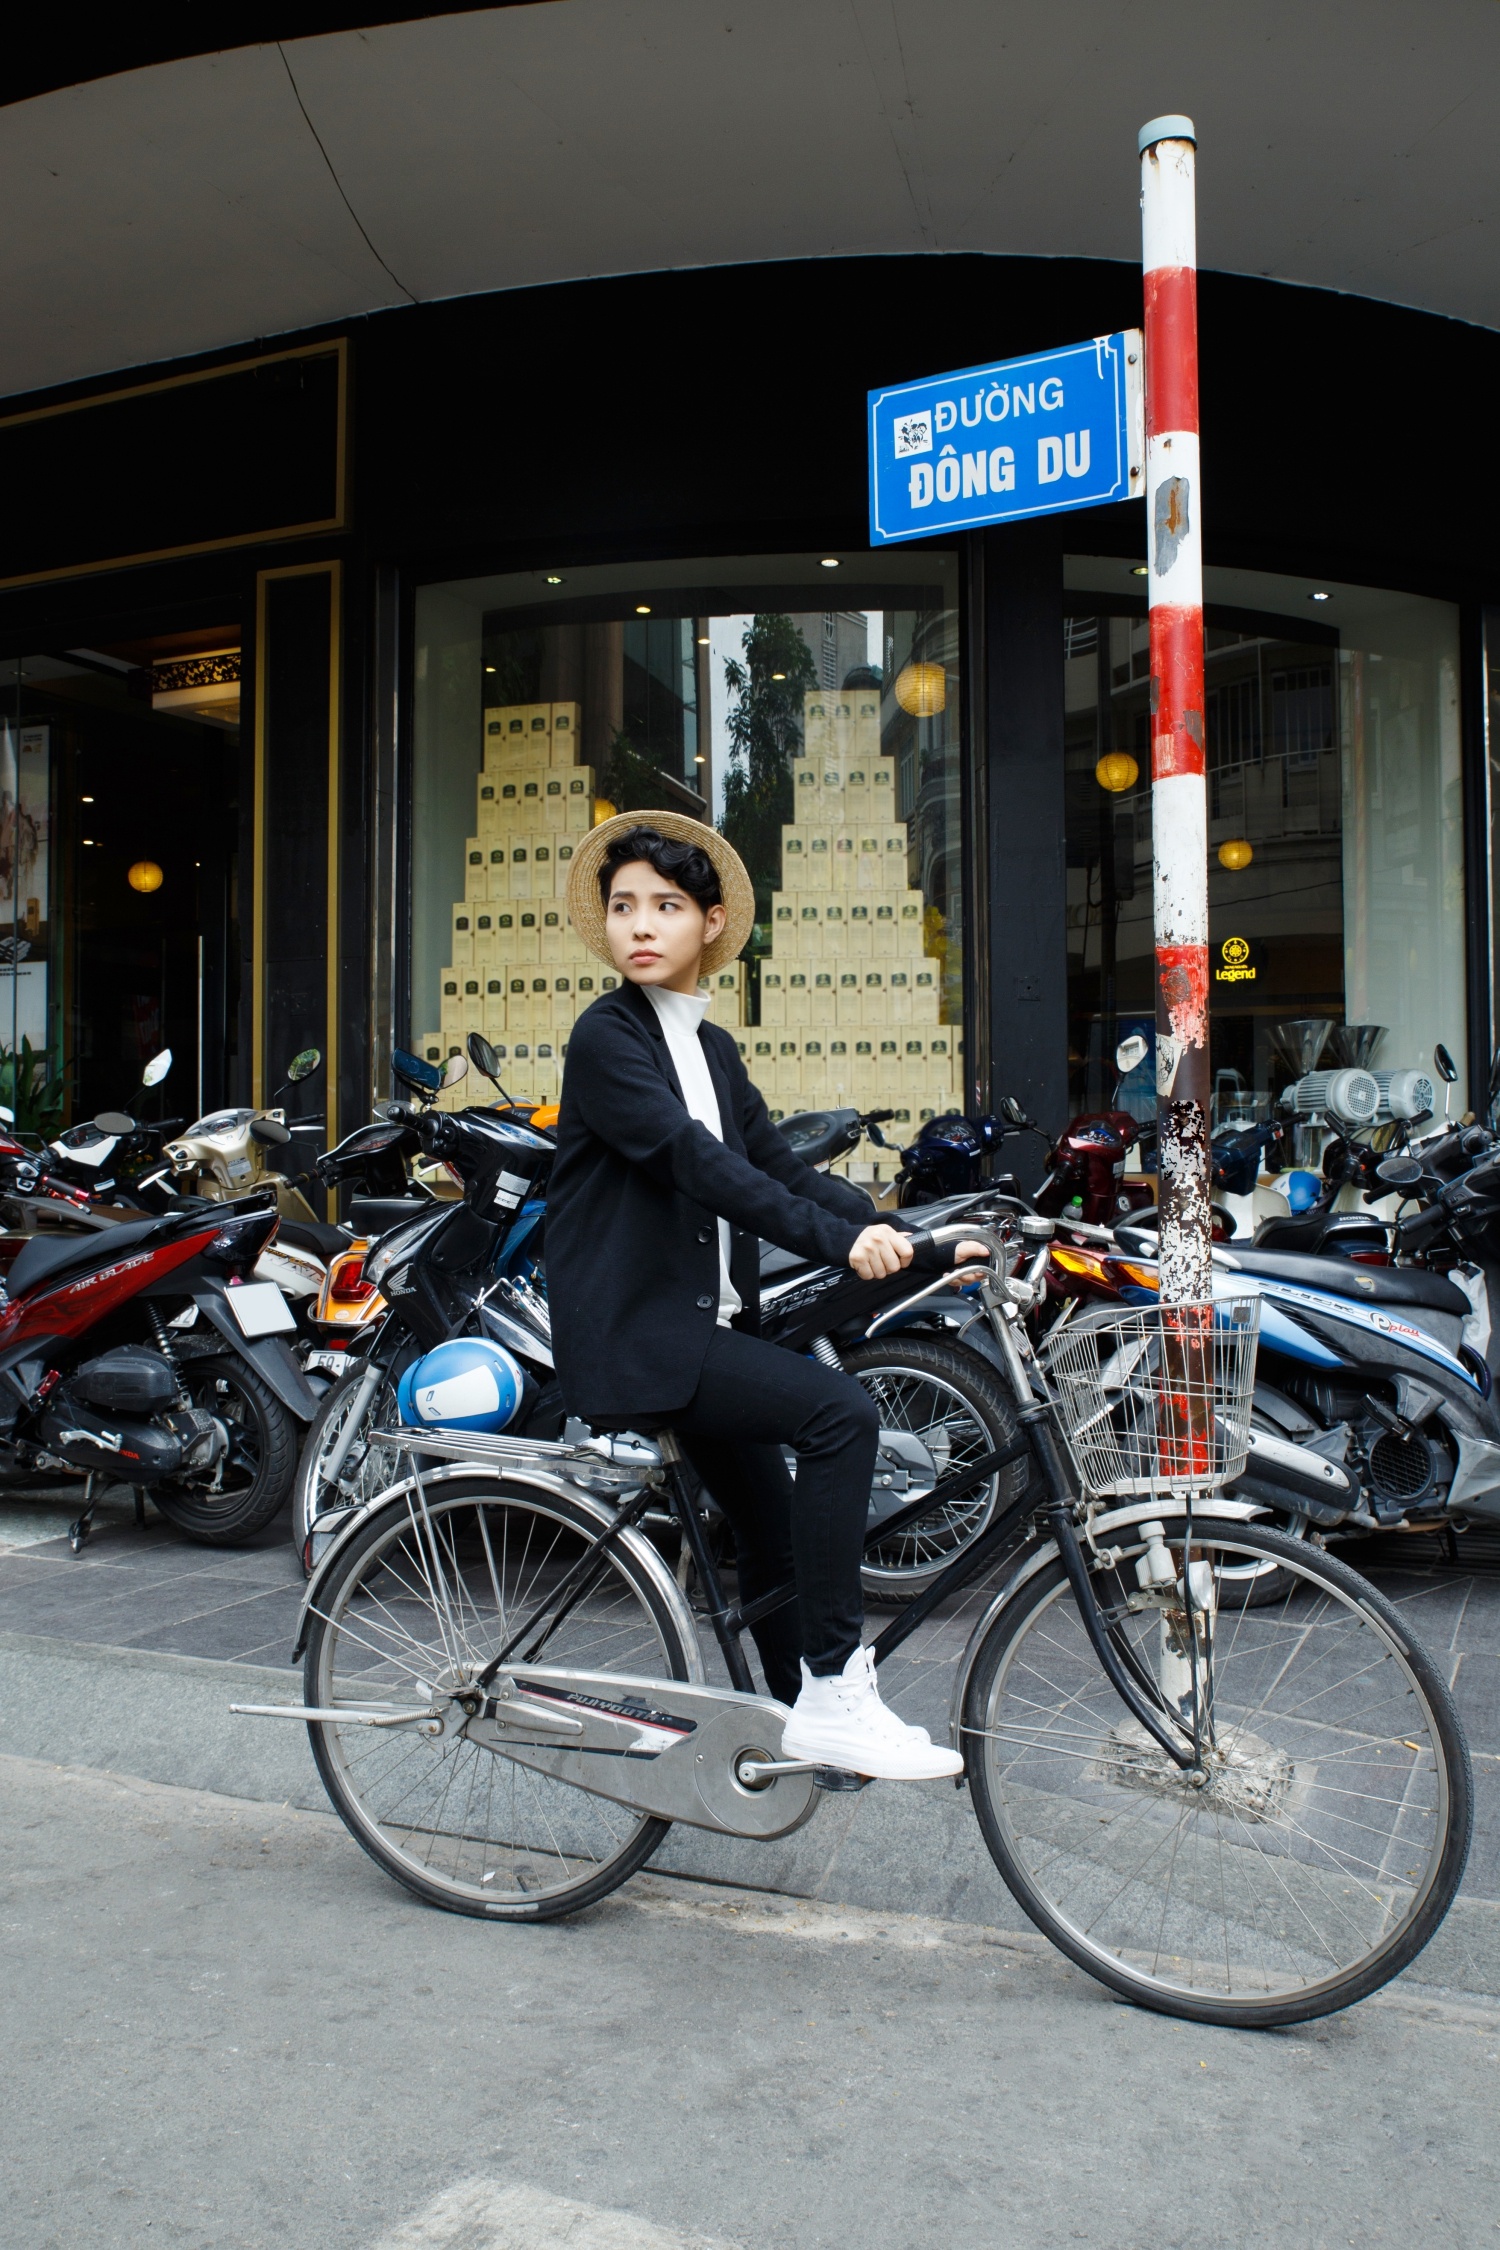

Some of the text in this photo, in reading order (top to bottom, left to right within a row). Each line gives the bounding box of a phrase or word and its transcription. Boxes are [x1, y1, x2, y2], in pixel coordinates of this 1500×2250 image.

[934, 377, 1064, 433] ĐƯỜNG
[909, 429, 1091, 509] ĐÔNG DU
[1216, 967, 1256, 982] Legend
[69, 1252, 155, 1294] AIR BLADE
[390, 1286, 417, 1297] HONDA
[779, 1293, 820, 1316] 125
[566, 1693, 659, 1721] FUJI YOUTH
